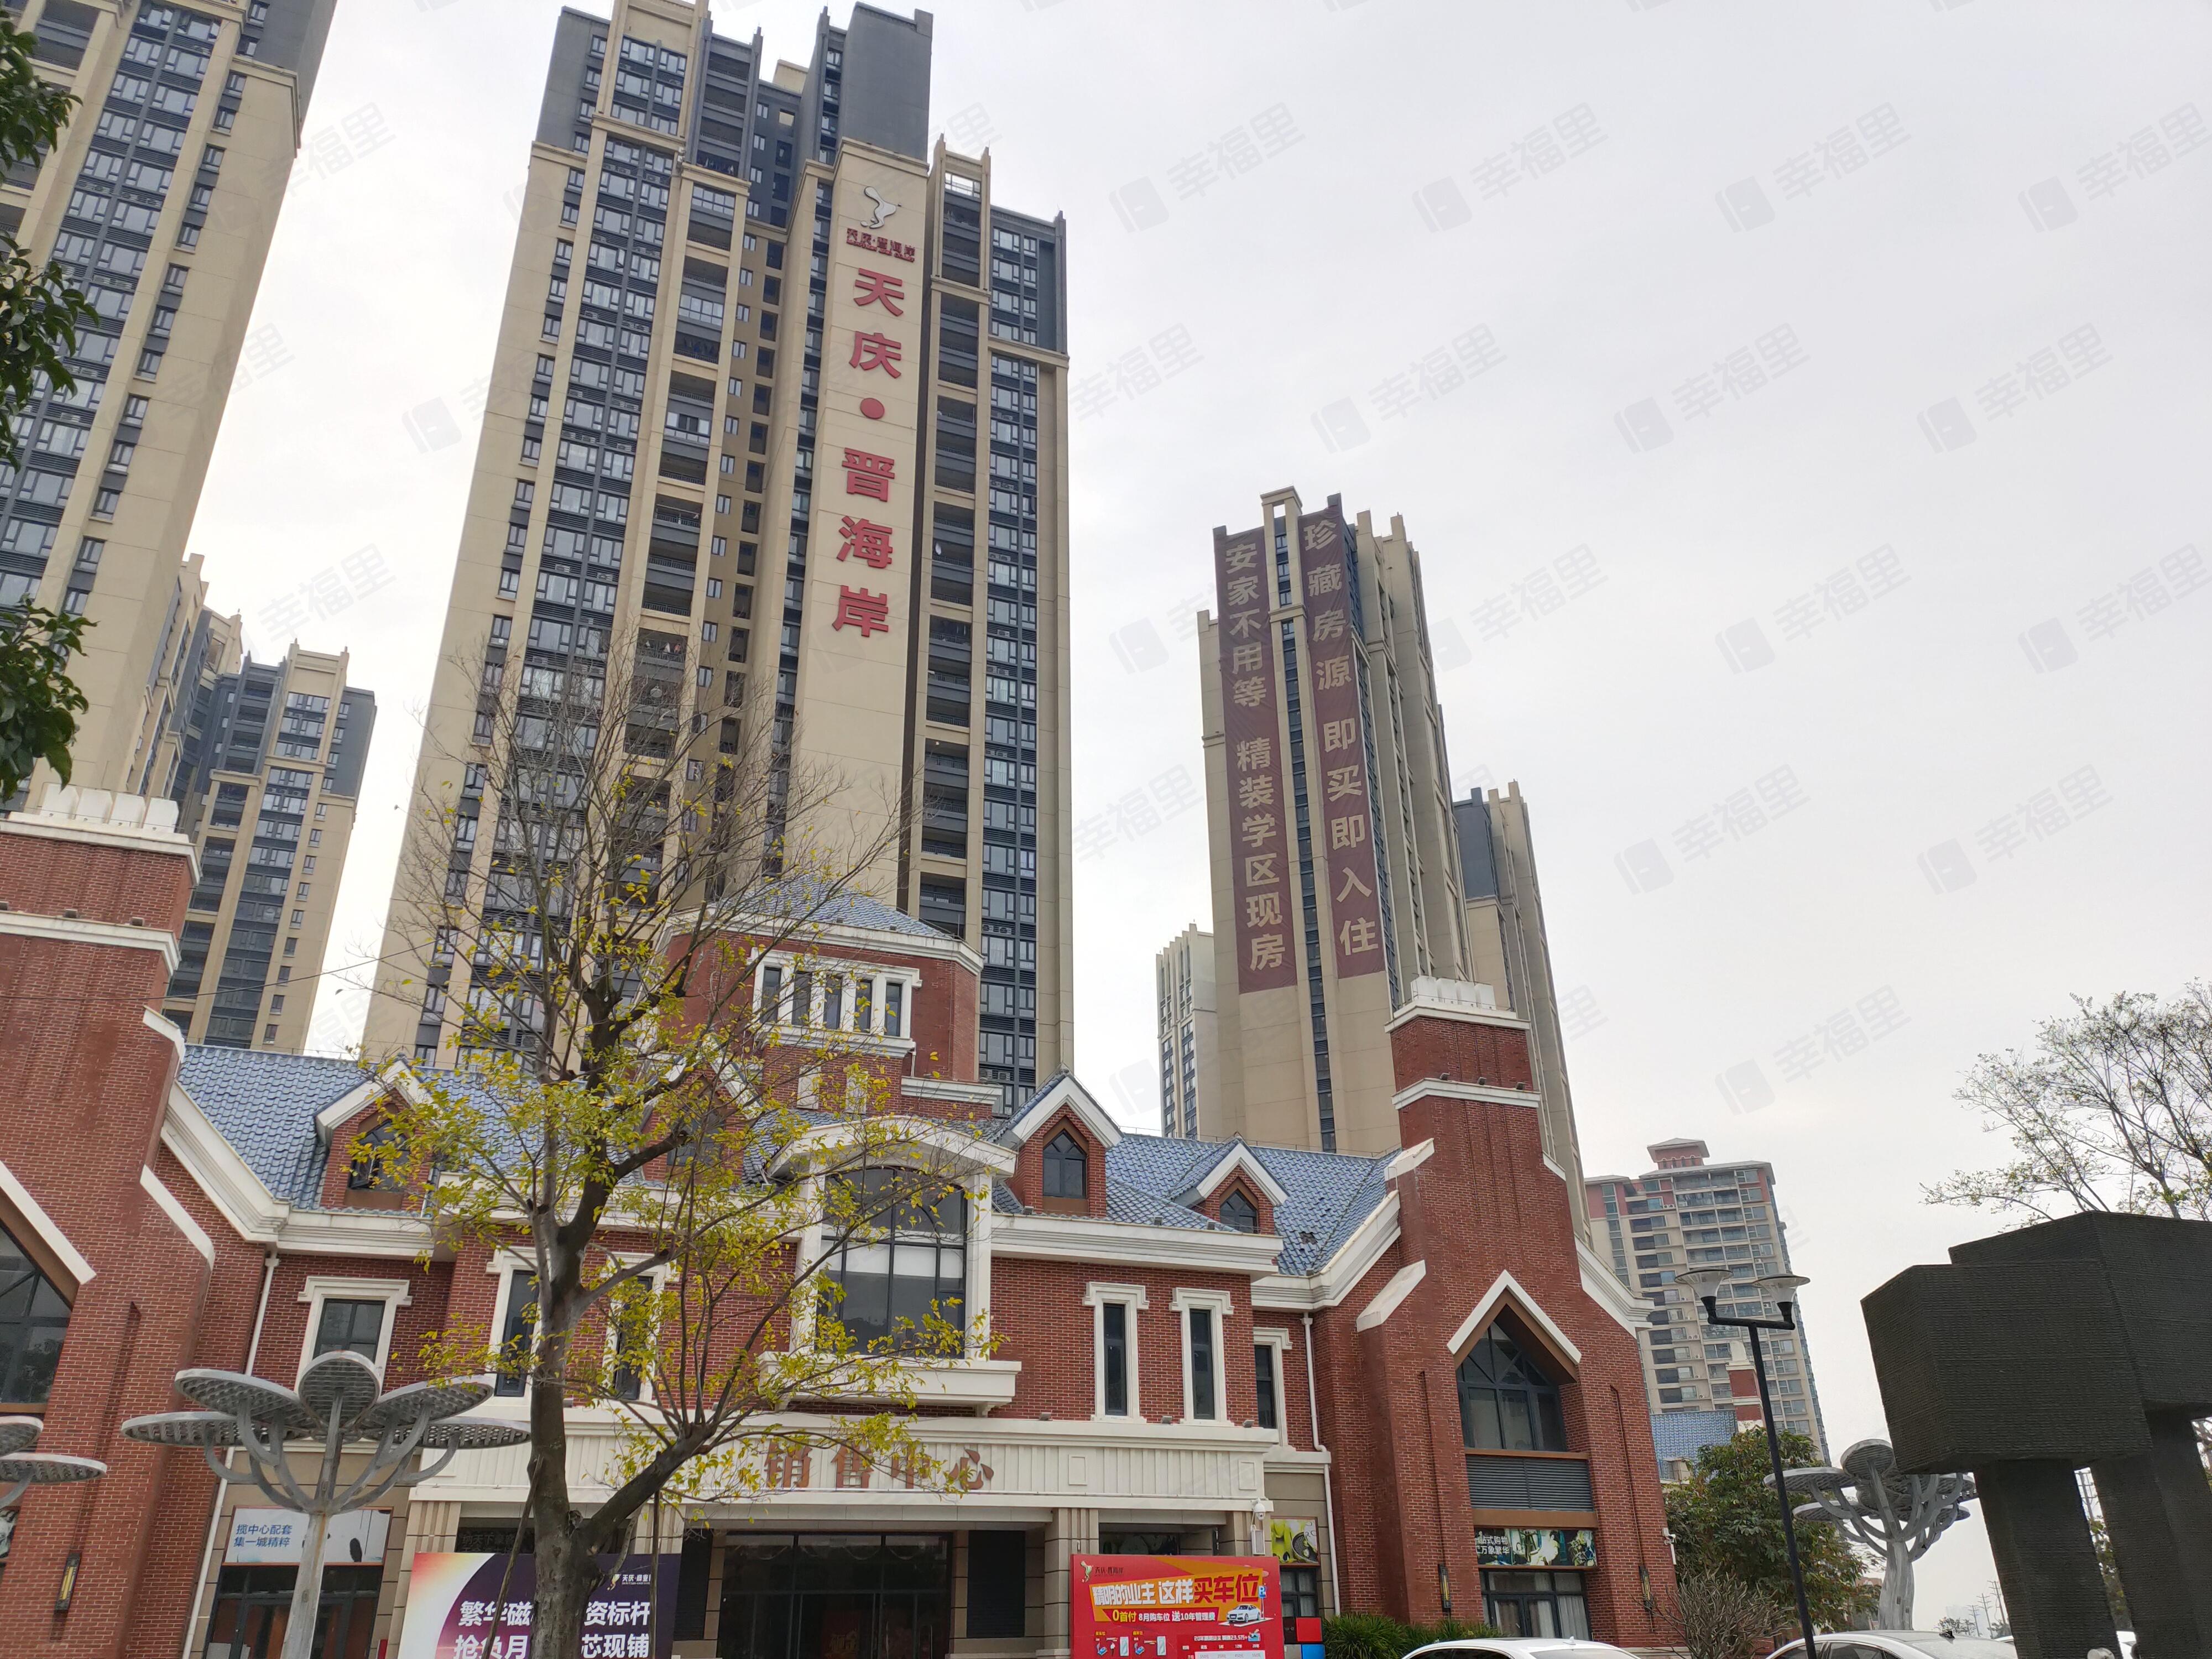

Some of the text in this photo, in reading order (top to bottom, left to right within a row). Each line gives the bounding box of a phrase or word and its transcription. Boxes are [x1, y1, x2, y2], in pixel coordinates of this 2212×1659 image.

[1225, 542, 1286, 972] 安家不用等 精装学区现房
[1303, 519, 1378, 957] 珍藏房源 即买即入住
[236, 1524, 292, 1535] 揽中心配套
[764, 1437, 994, 1490] 销售中心
